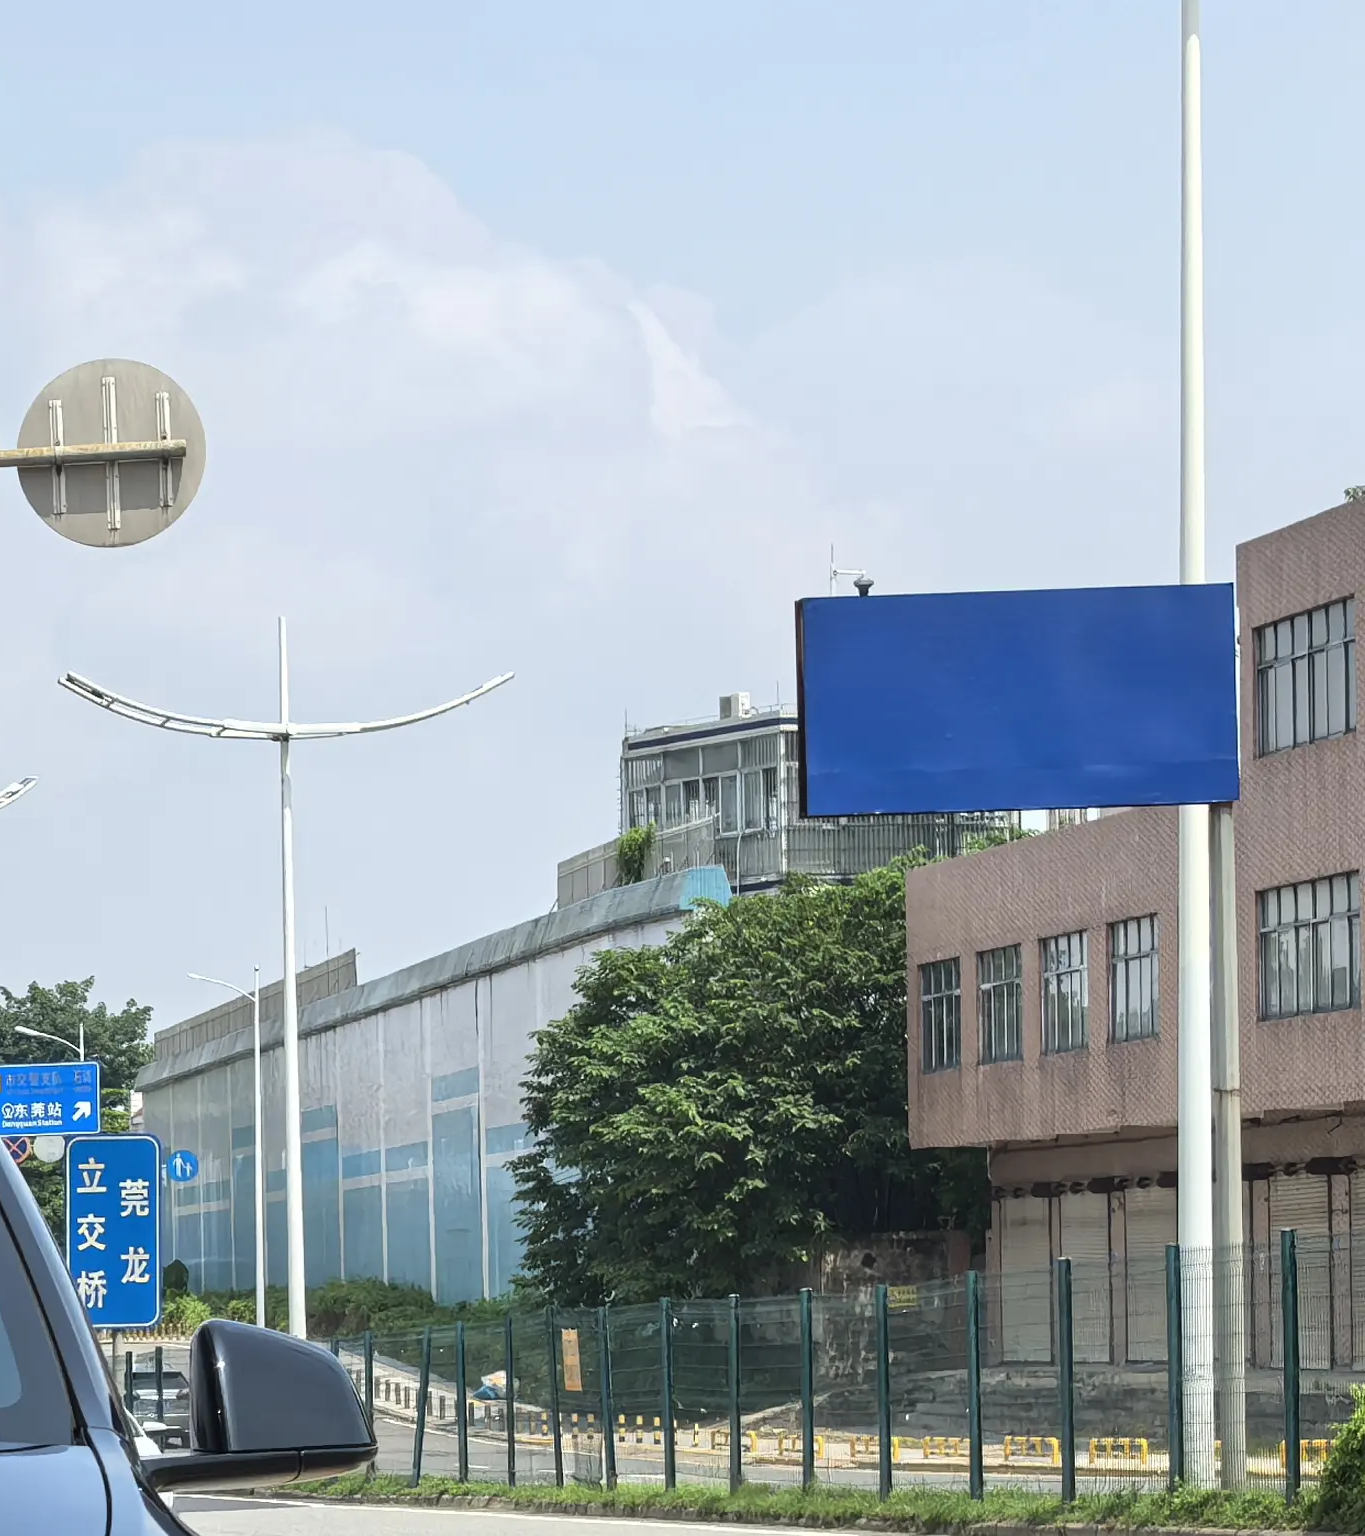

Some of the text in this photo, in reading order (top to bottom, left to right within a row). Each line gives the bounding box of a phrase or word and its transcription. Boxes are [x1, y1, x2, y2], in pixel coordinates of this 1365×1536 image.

[14, 1101, 63, 1118] 东莞站
[76, 1157, 107, 1309] 立交桥
[119, 1179, 151, 1284] 莞龙
